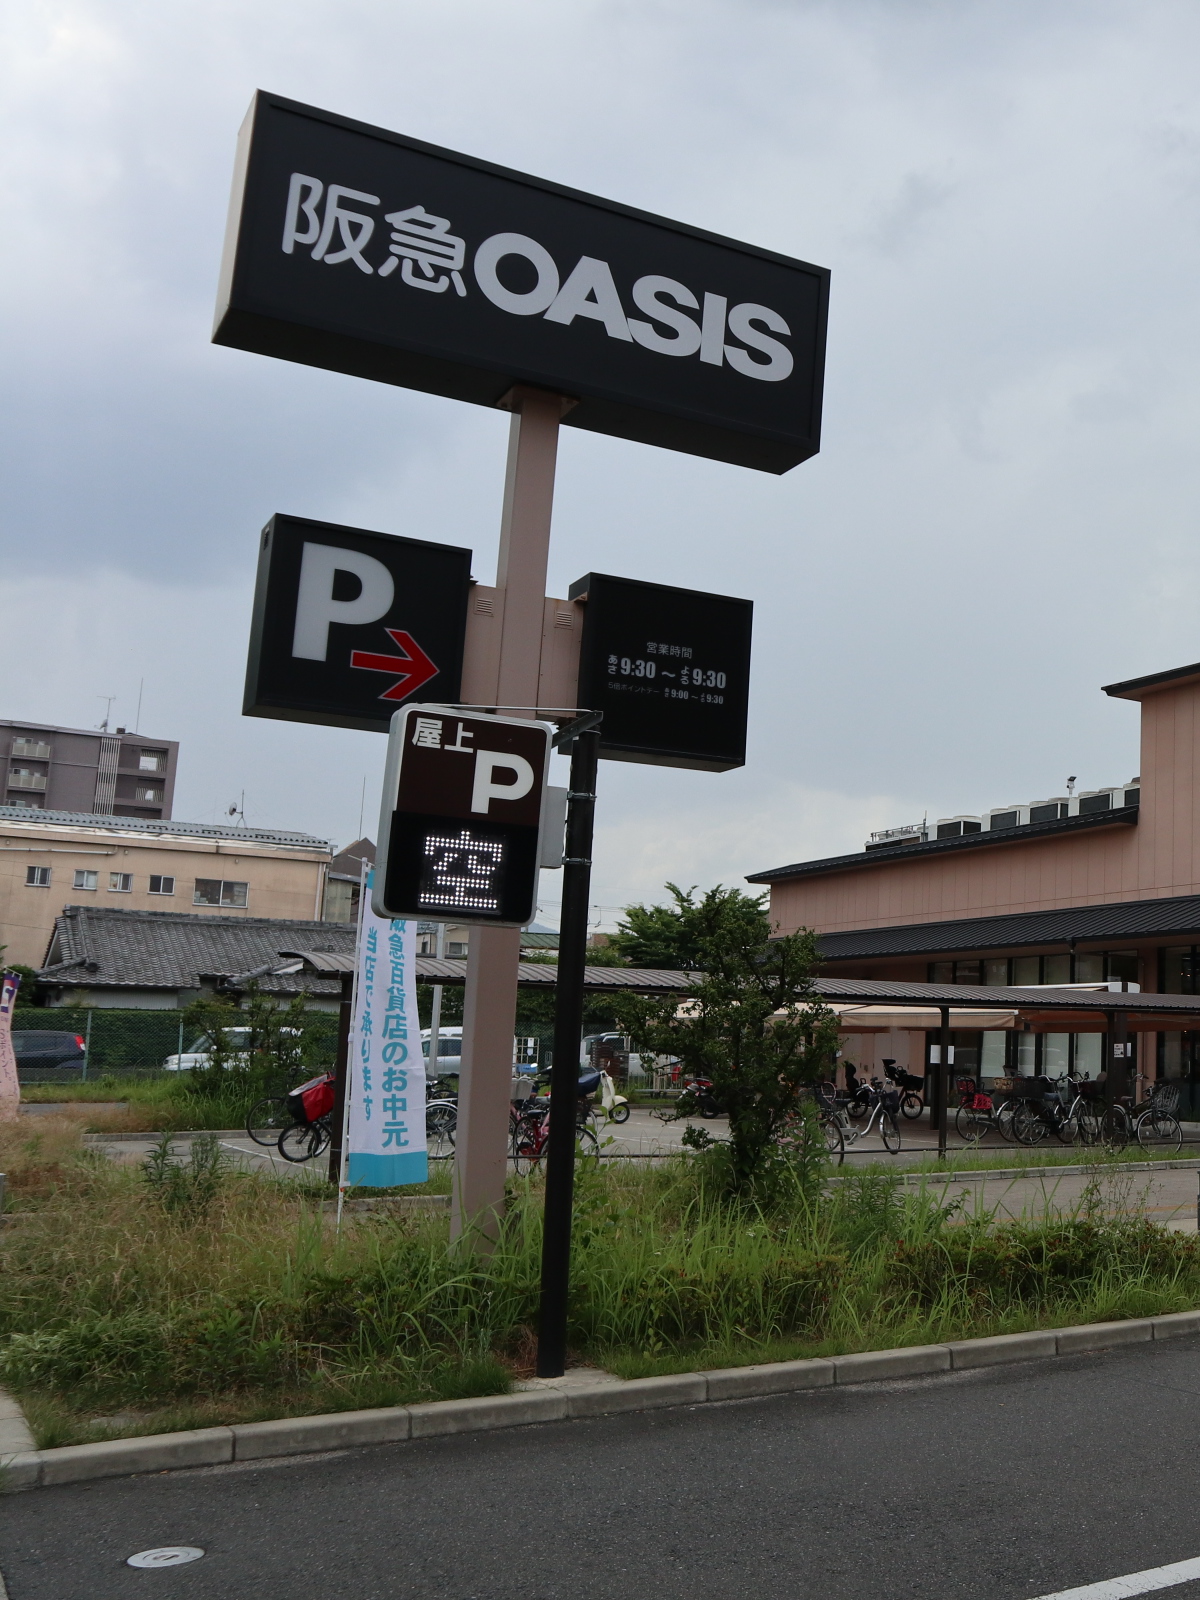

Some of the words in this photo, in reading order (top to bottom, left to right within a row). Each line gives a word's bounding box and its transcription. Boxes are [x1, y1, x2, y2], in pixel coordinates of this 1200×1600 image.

[282, 172, 794, 382] 阪急OASIS
[292, 541, 395, 662] P
[620, 657, 656, 679] 9:30
[692, 668, 727, 689] 9:30
[646, 641, 693, 659] 営業時間
[411, 717, 474, 754] 屋上
[470, 750, 535, 814] P
[418, 828, 503, 910] 空
[360, 925, 378, 1121] 当店で承ります
